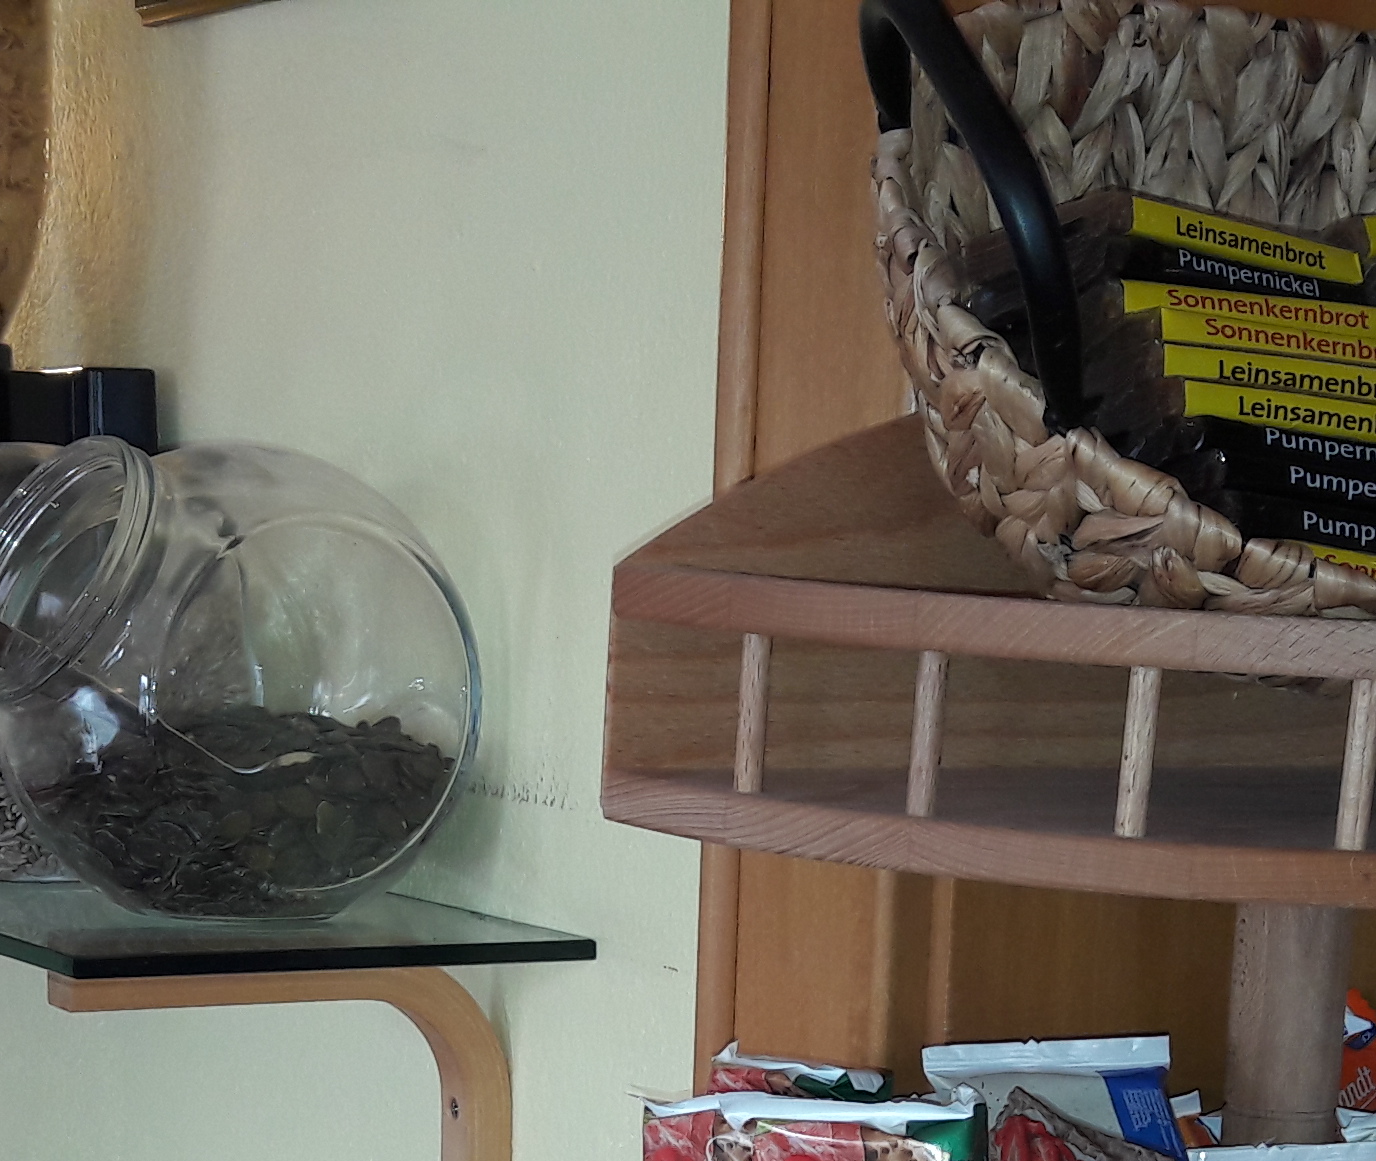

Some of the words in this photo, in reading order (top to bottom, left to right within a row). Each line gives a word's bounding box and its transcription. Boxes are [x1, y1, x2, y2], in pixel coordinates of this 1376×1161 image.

[1175, 215, 1328, 271] Leinsamenbrot
[1178, 248, 1321, 299] Pumpernickel
[1167, 288, 1370, 331] Sonnenkernbrot
